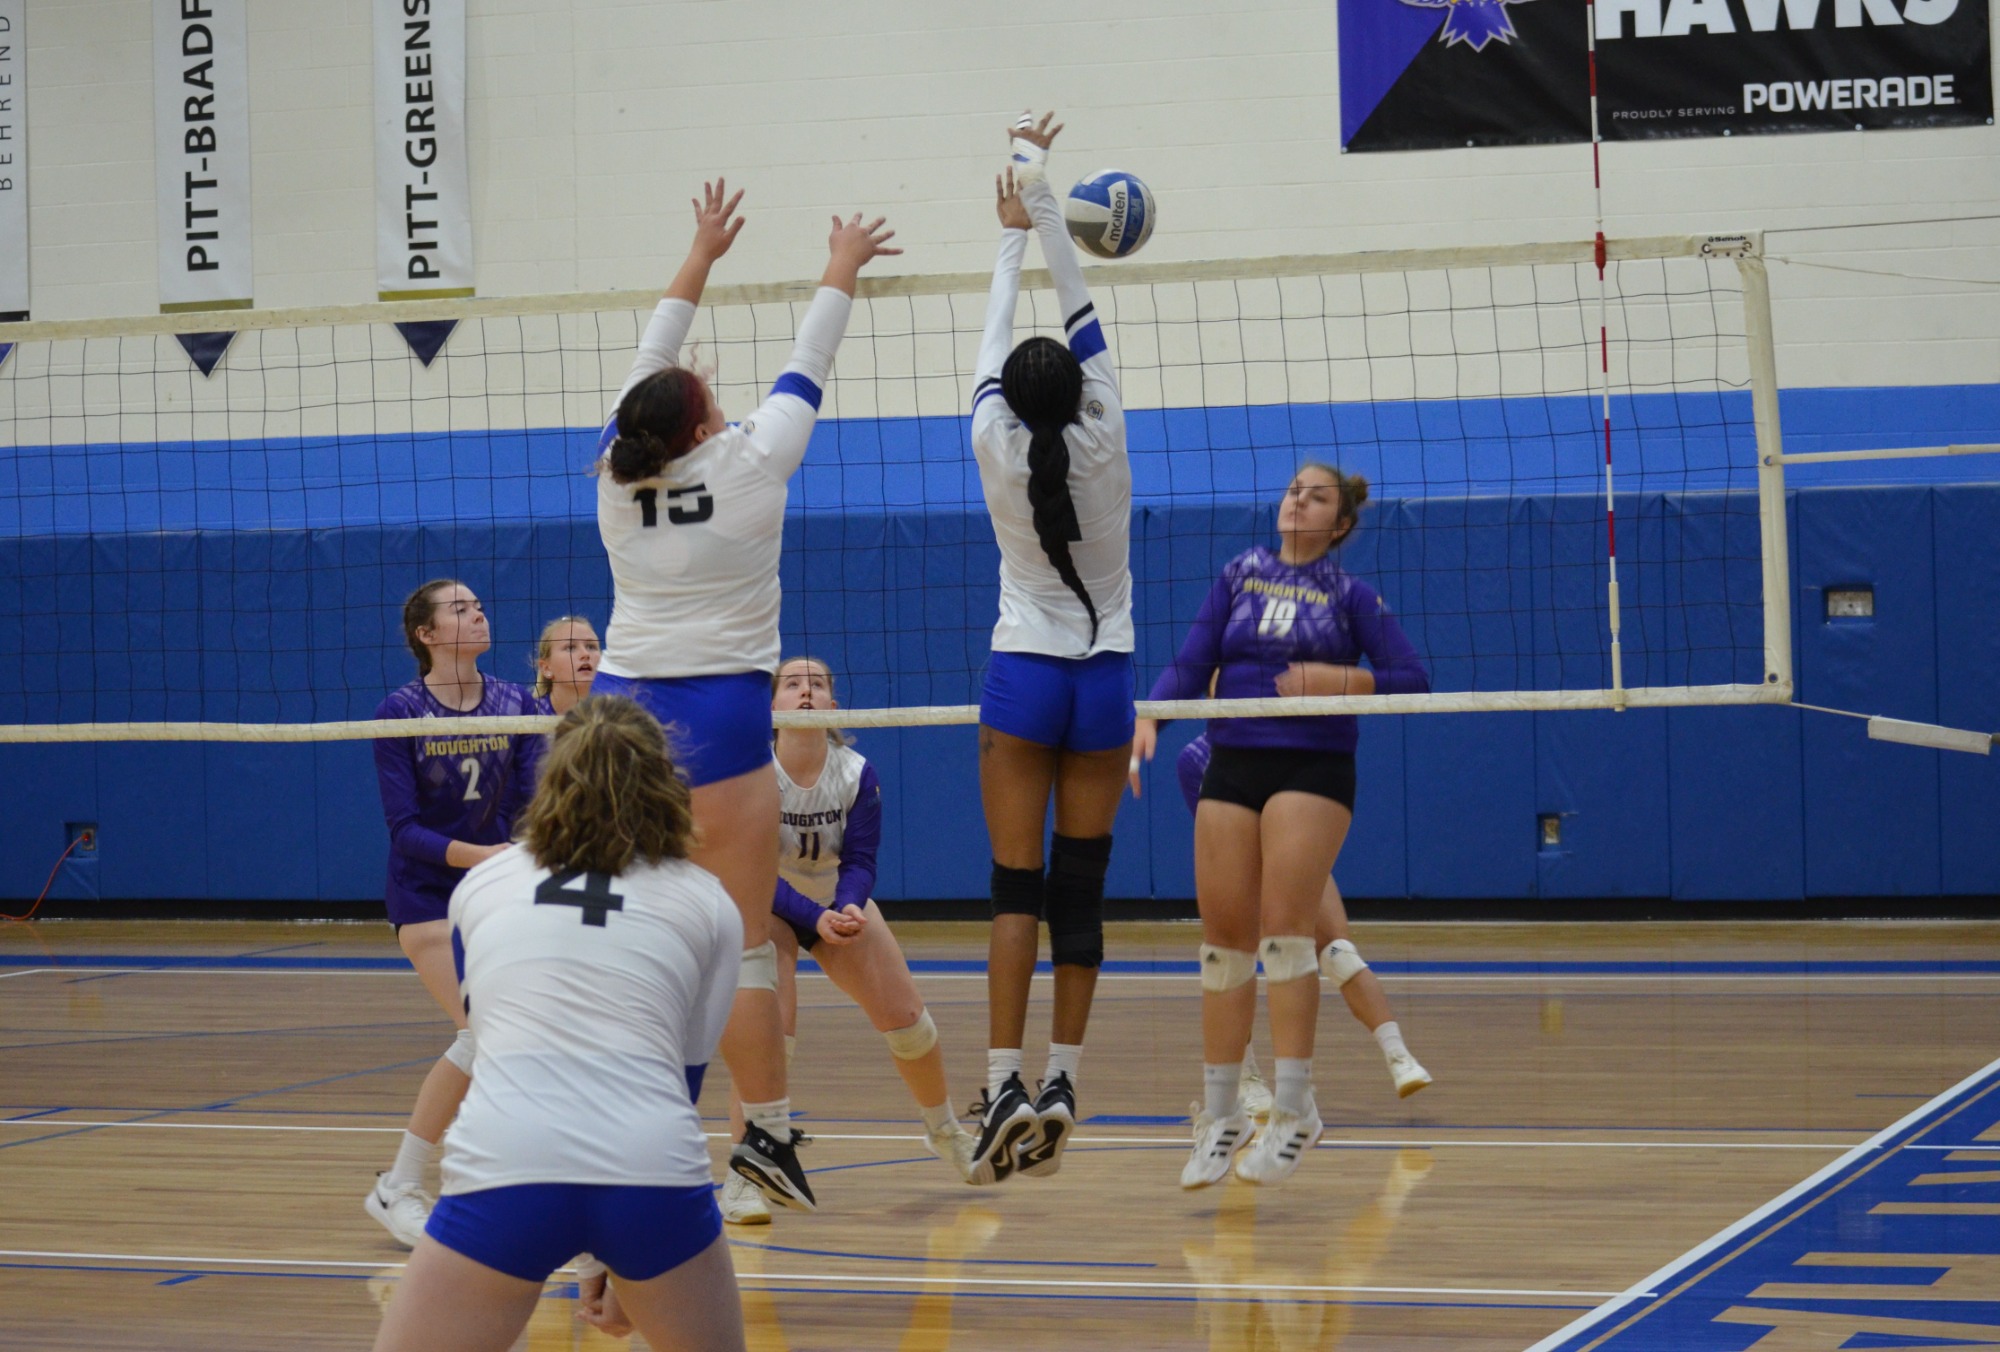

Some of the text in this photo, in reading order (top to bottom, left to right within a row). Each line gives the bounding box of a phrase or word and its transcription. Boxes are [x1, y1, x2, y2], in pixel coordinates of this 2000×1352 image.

[1612, 106, 1736, 120] PROUDLY SERVING
[1743, 74, 1955, 113] POWERADE
[1109, 191, 1125, 242] molten
[633, 482, 713, 527] 15
[1257, 596, 1297, 638] 19
[425, 735, 510, 756] HOUGHTON
[460, 757, 482, 801] 2
[798, 832, 821, 861] 11
[534, 865, 624, 927] 4
